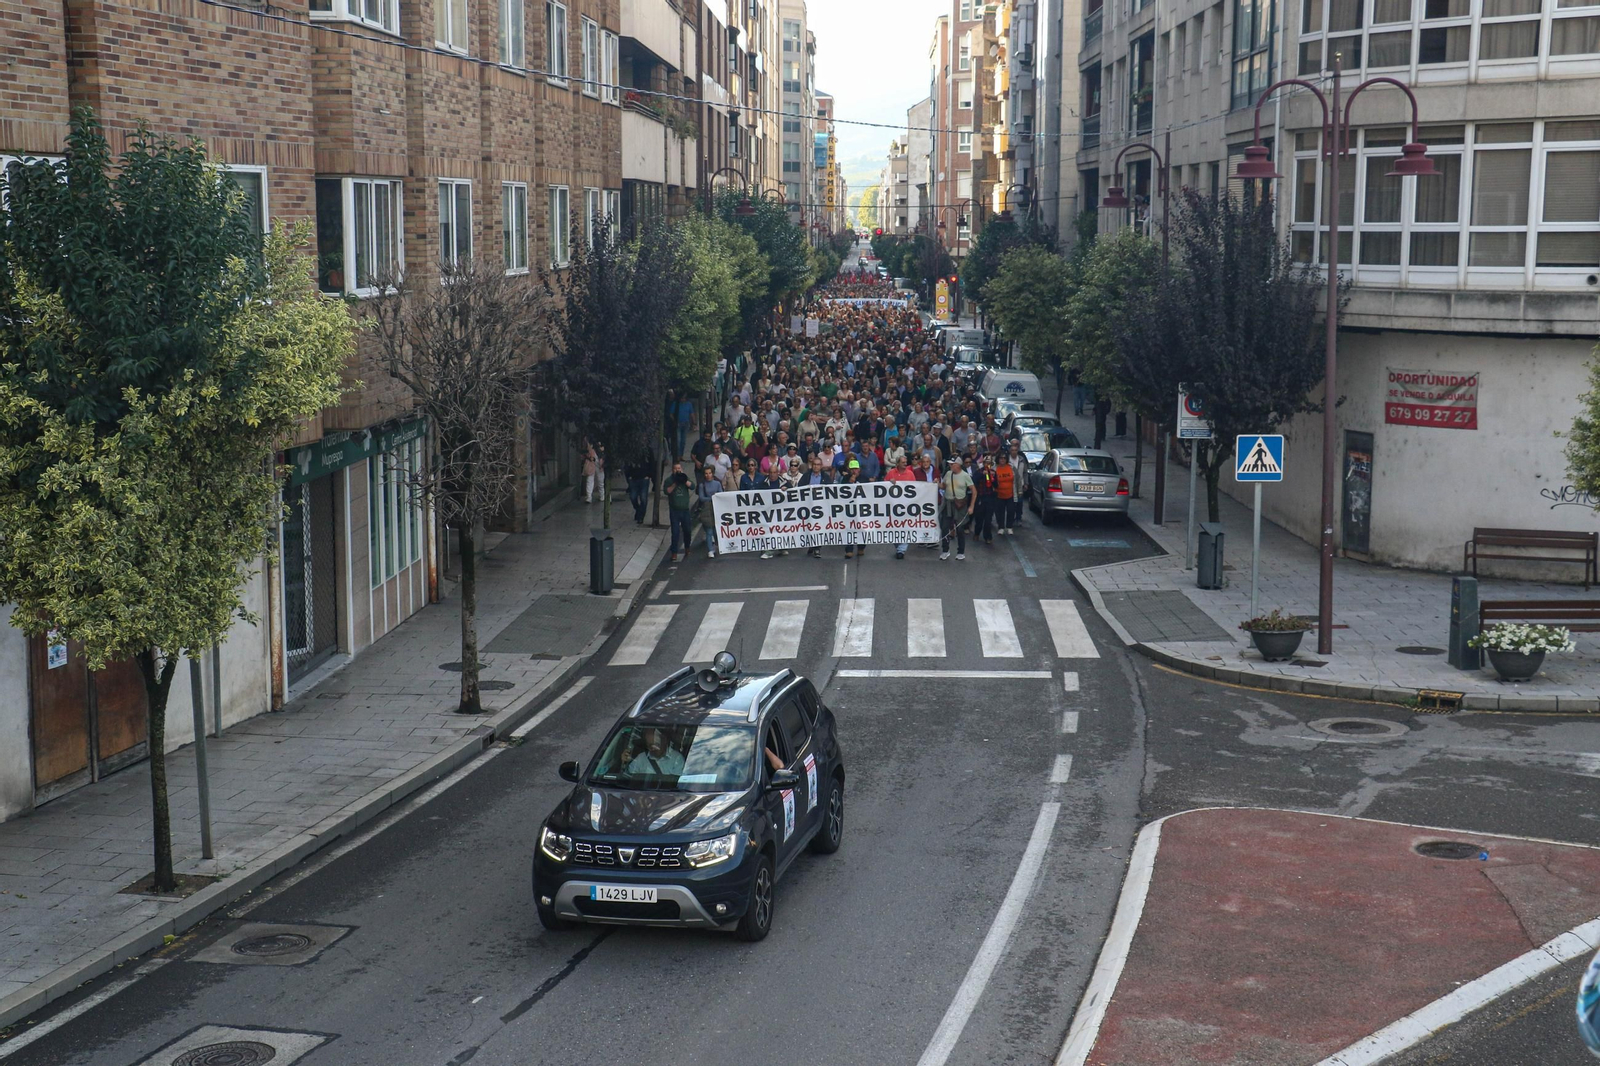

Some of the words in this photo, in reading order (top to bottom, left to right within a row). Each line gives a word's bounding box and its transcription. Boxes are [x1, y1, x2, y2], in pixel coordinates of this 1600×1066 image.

[1388, 373, 1477, 387] OPORTUNIDAD
[1388, 389, 1398, 397] SE
[1400, 390, 1426, 399] VENDE
[1436, 392, 1475, 401] ALQUILA
[1390, 407, 1411, 419] 679
[1415, 408, 1430, 420] 09
[1434, 410, 1450, 421] 27
[1454, 411, 1471, 422] 27
[736, 492, 762, 507] NA
[771, 485, 867, 505] DEFENSA
[873, 484, 917, 499] DOS
[720, 505, 824, 526] SERVIZOS
[831, 501, 936, 519] PÚBLICOS
[720, 523, 742, 539] Non
[746, 525, 766, 536] aos
[769, 517, 821, 534] recortes
[825, 516, 845, 530] dos
[850, 518, 881, 530] nosos
[886, 513, 937, 529] dereitos
[740, 537, 796, 551] PLATAFORMA
[800, 532, 843, 548] SANITARIA
[847, 532, 858, 544] DE
[861, 530, 918, 544] VALDEORRAS
[600, 888, 628, 900] 1429
[631, 889, 654, 901] LJV
